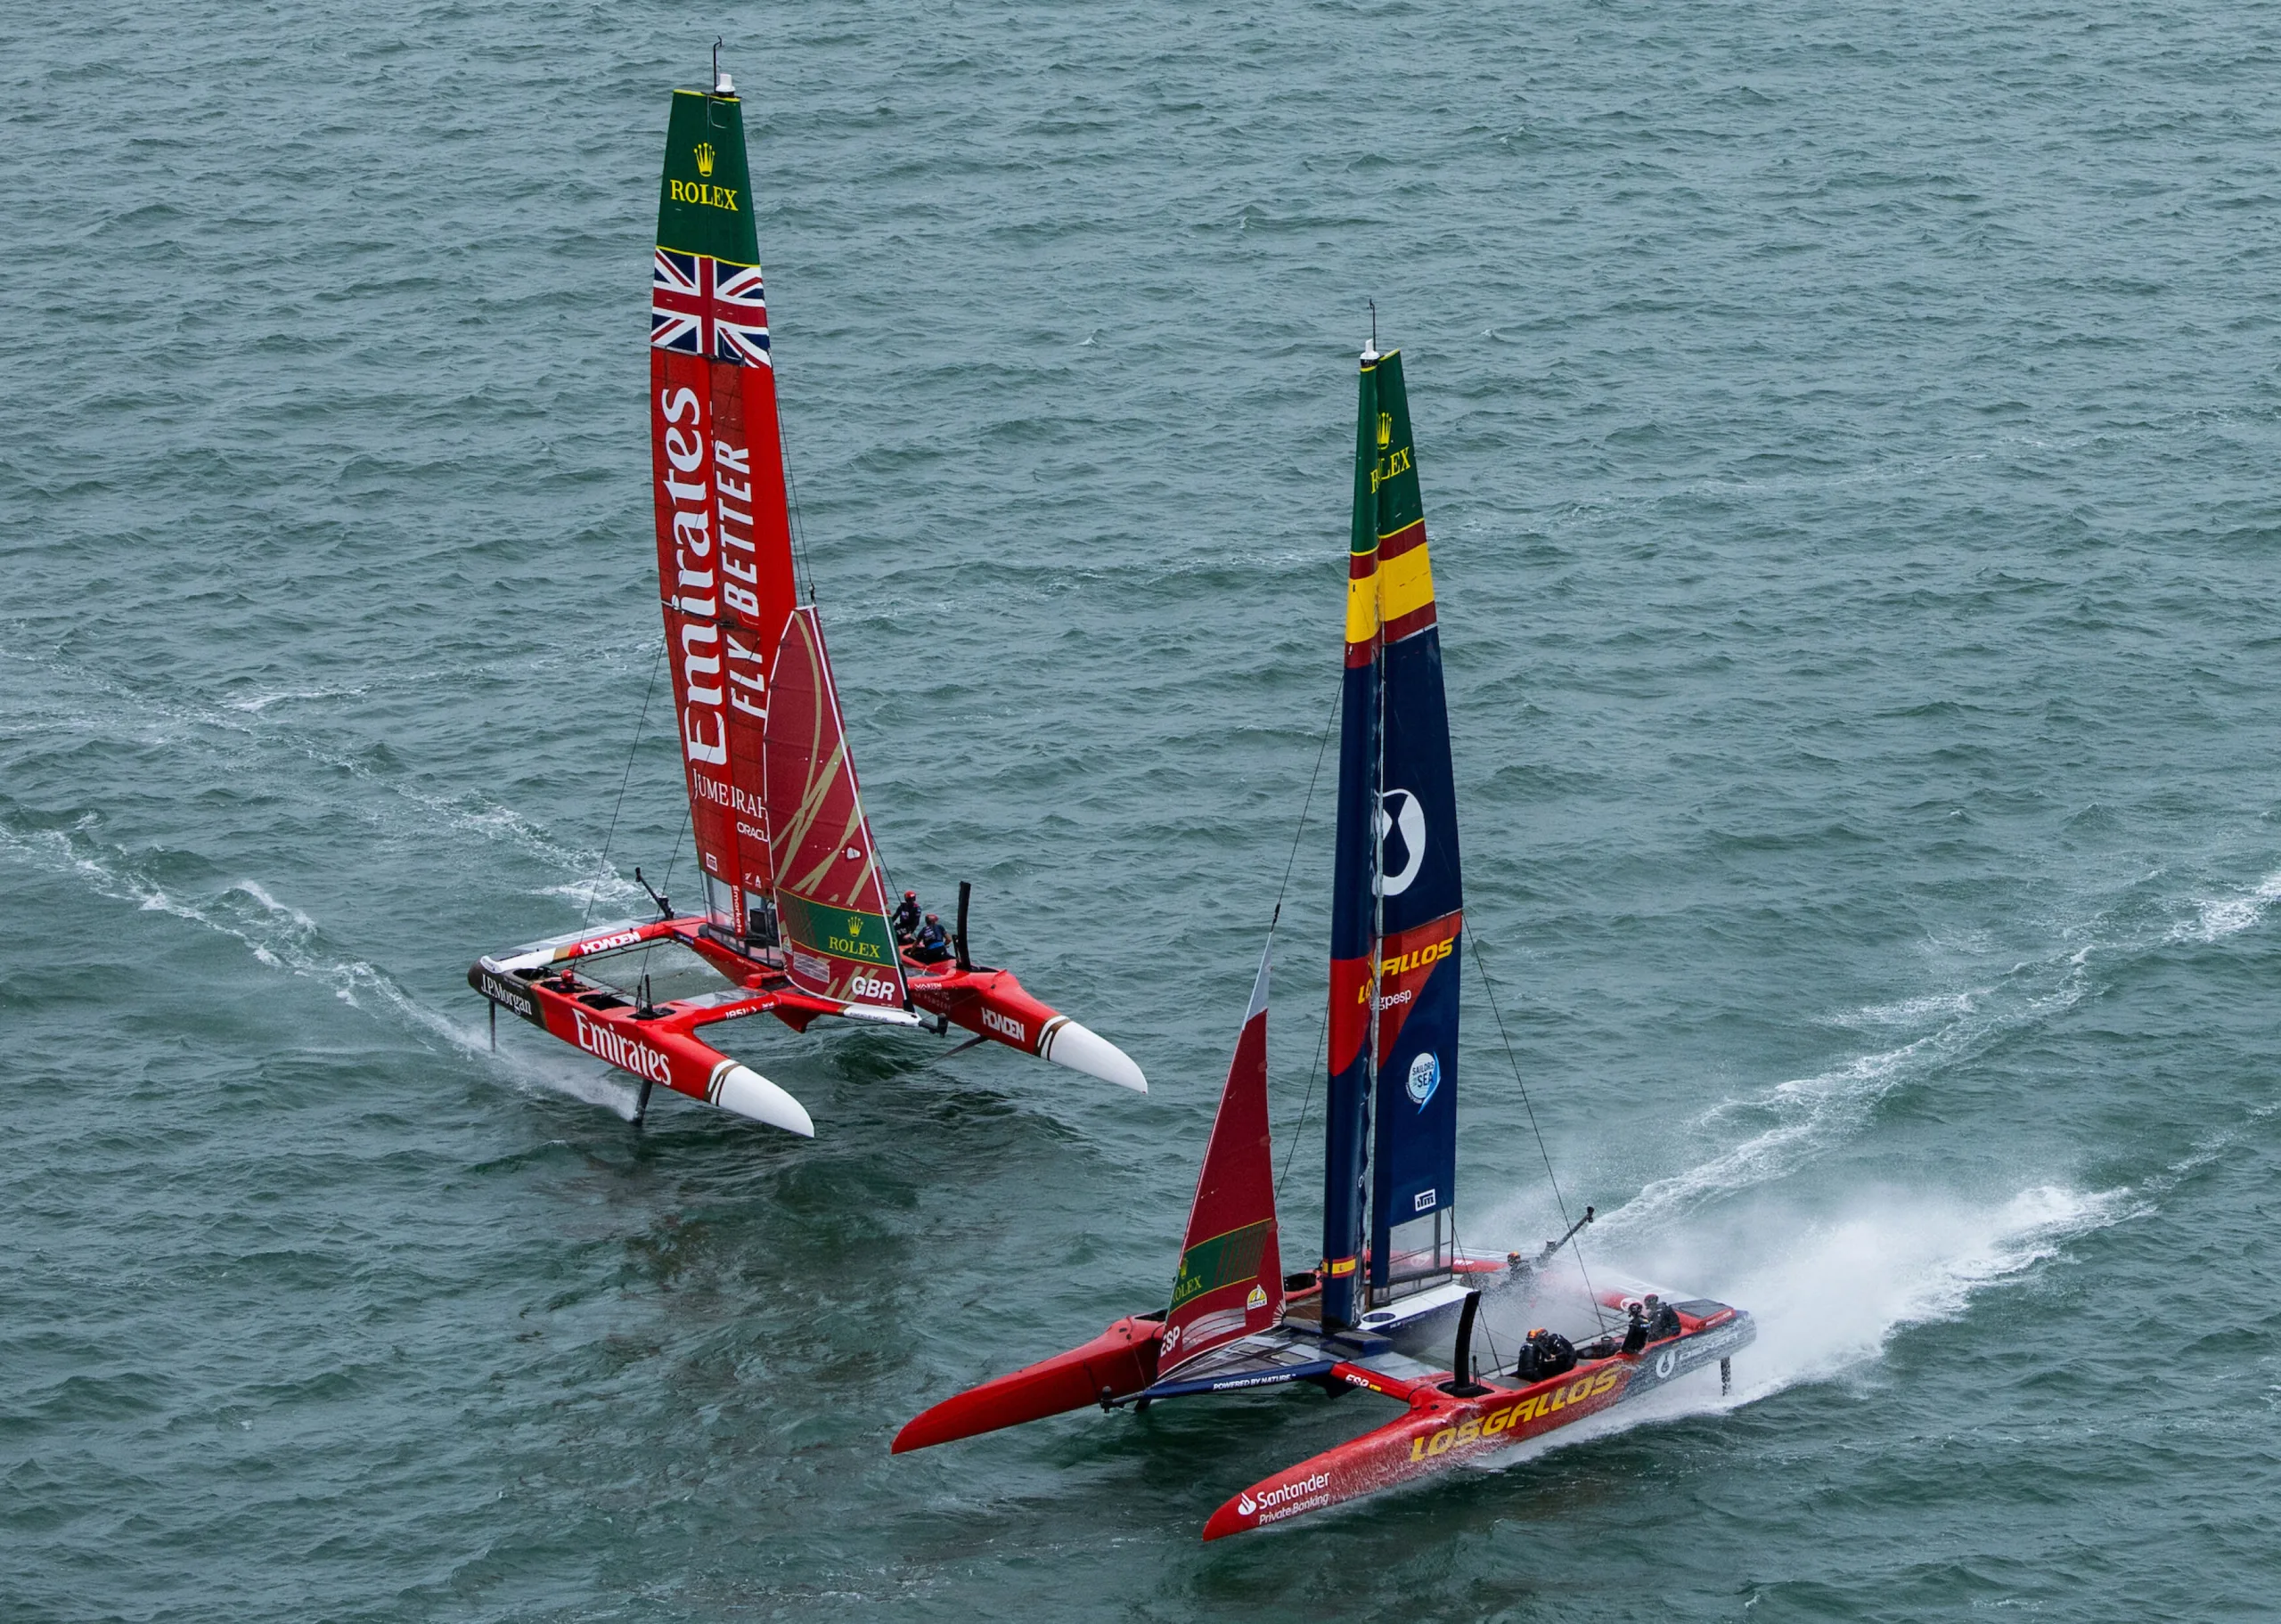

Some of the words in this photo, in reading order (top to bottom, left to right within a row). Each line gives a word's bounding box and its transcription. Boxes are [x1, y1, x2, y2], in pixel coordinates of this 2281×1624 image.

[670, 179, 739, 211] ROLEX
[1370, 446, 1410, 494] RLEX
[715, 440, 759, 618] BETTER
[661, 386, 727, 765] Emirates
[727, 632, 767, 719] FLY
[737, 821, 769, 842] ORACL
[580, 931, 642, 955] HOWDEN
[829, 936, 880, 959] ROLEX
[852, 976, 895, 1000] GBR
[981, 1007, 1025, 1042] HOWDEN
[572, 1008, 673, 1086] Emirates
[1418, 1072, 1434, 1088] SEA
[1160, 1326, 1181, 1357] ESP
[1213, 1379, 1250, 1391] POWERED
[1251, 1377, 1261, 1386] BY
[1262, 1374, 1291, 1384] NATURE
[1257, 1473, 1330, 1510] Santander
[1259, 1506, 1291, 1525] Private
[1292, 1493, 1329, 1514] Banking
